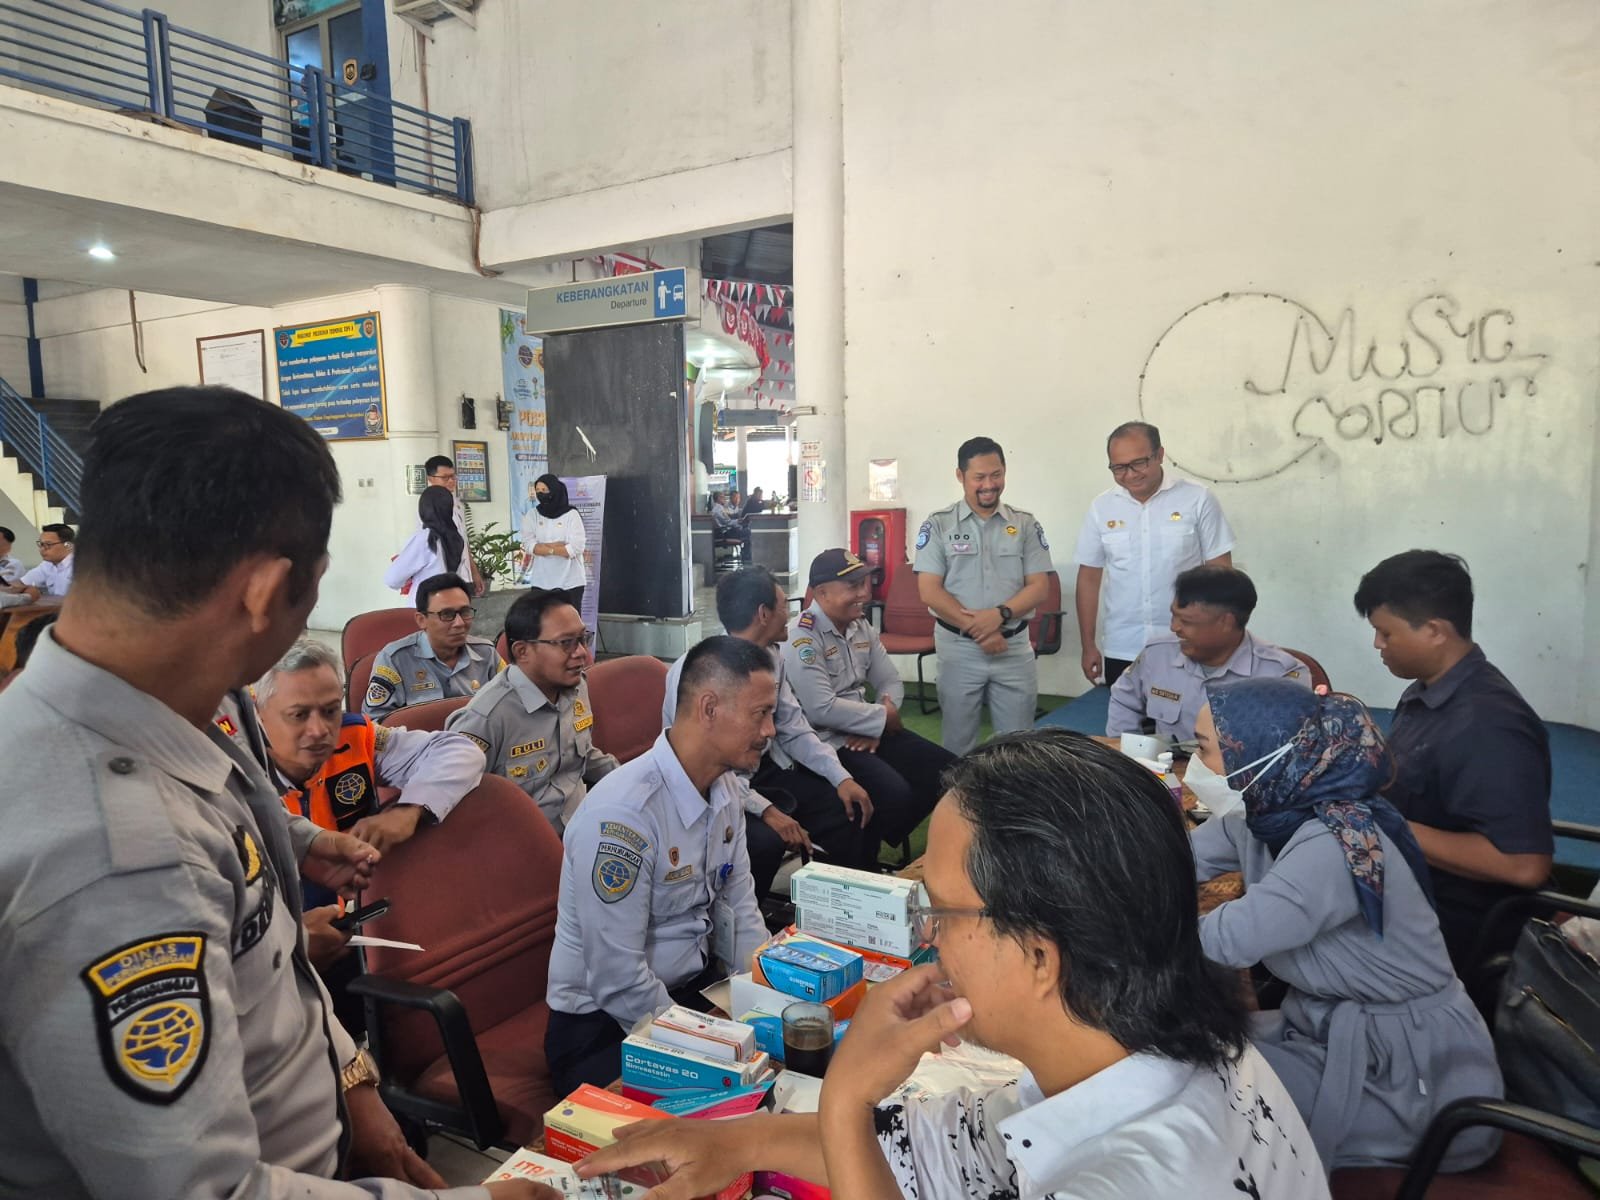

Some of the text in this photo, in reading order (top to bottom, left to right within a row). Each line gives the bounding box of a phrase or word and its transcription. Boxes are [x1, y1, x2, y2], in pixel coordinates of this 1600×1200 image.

[556, 281, 649, 304] KEBERANGKATAN
[611, 298, 647, 310] Departure
[601, 843, 641, 866] PERHUBUNGAN
[120, 943, 178, 968] DINAS
[625, 1054, 679, 1075] Cortavas
[681, 1070, 699, 1079] 20
